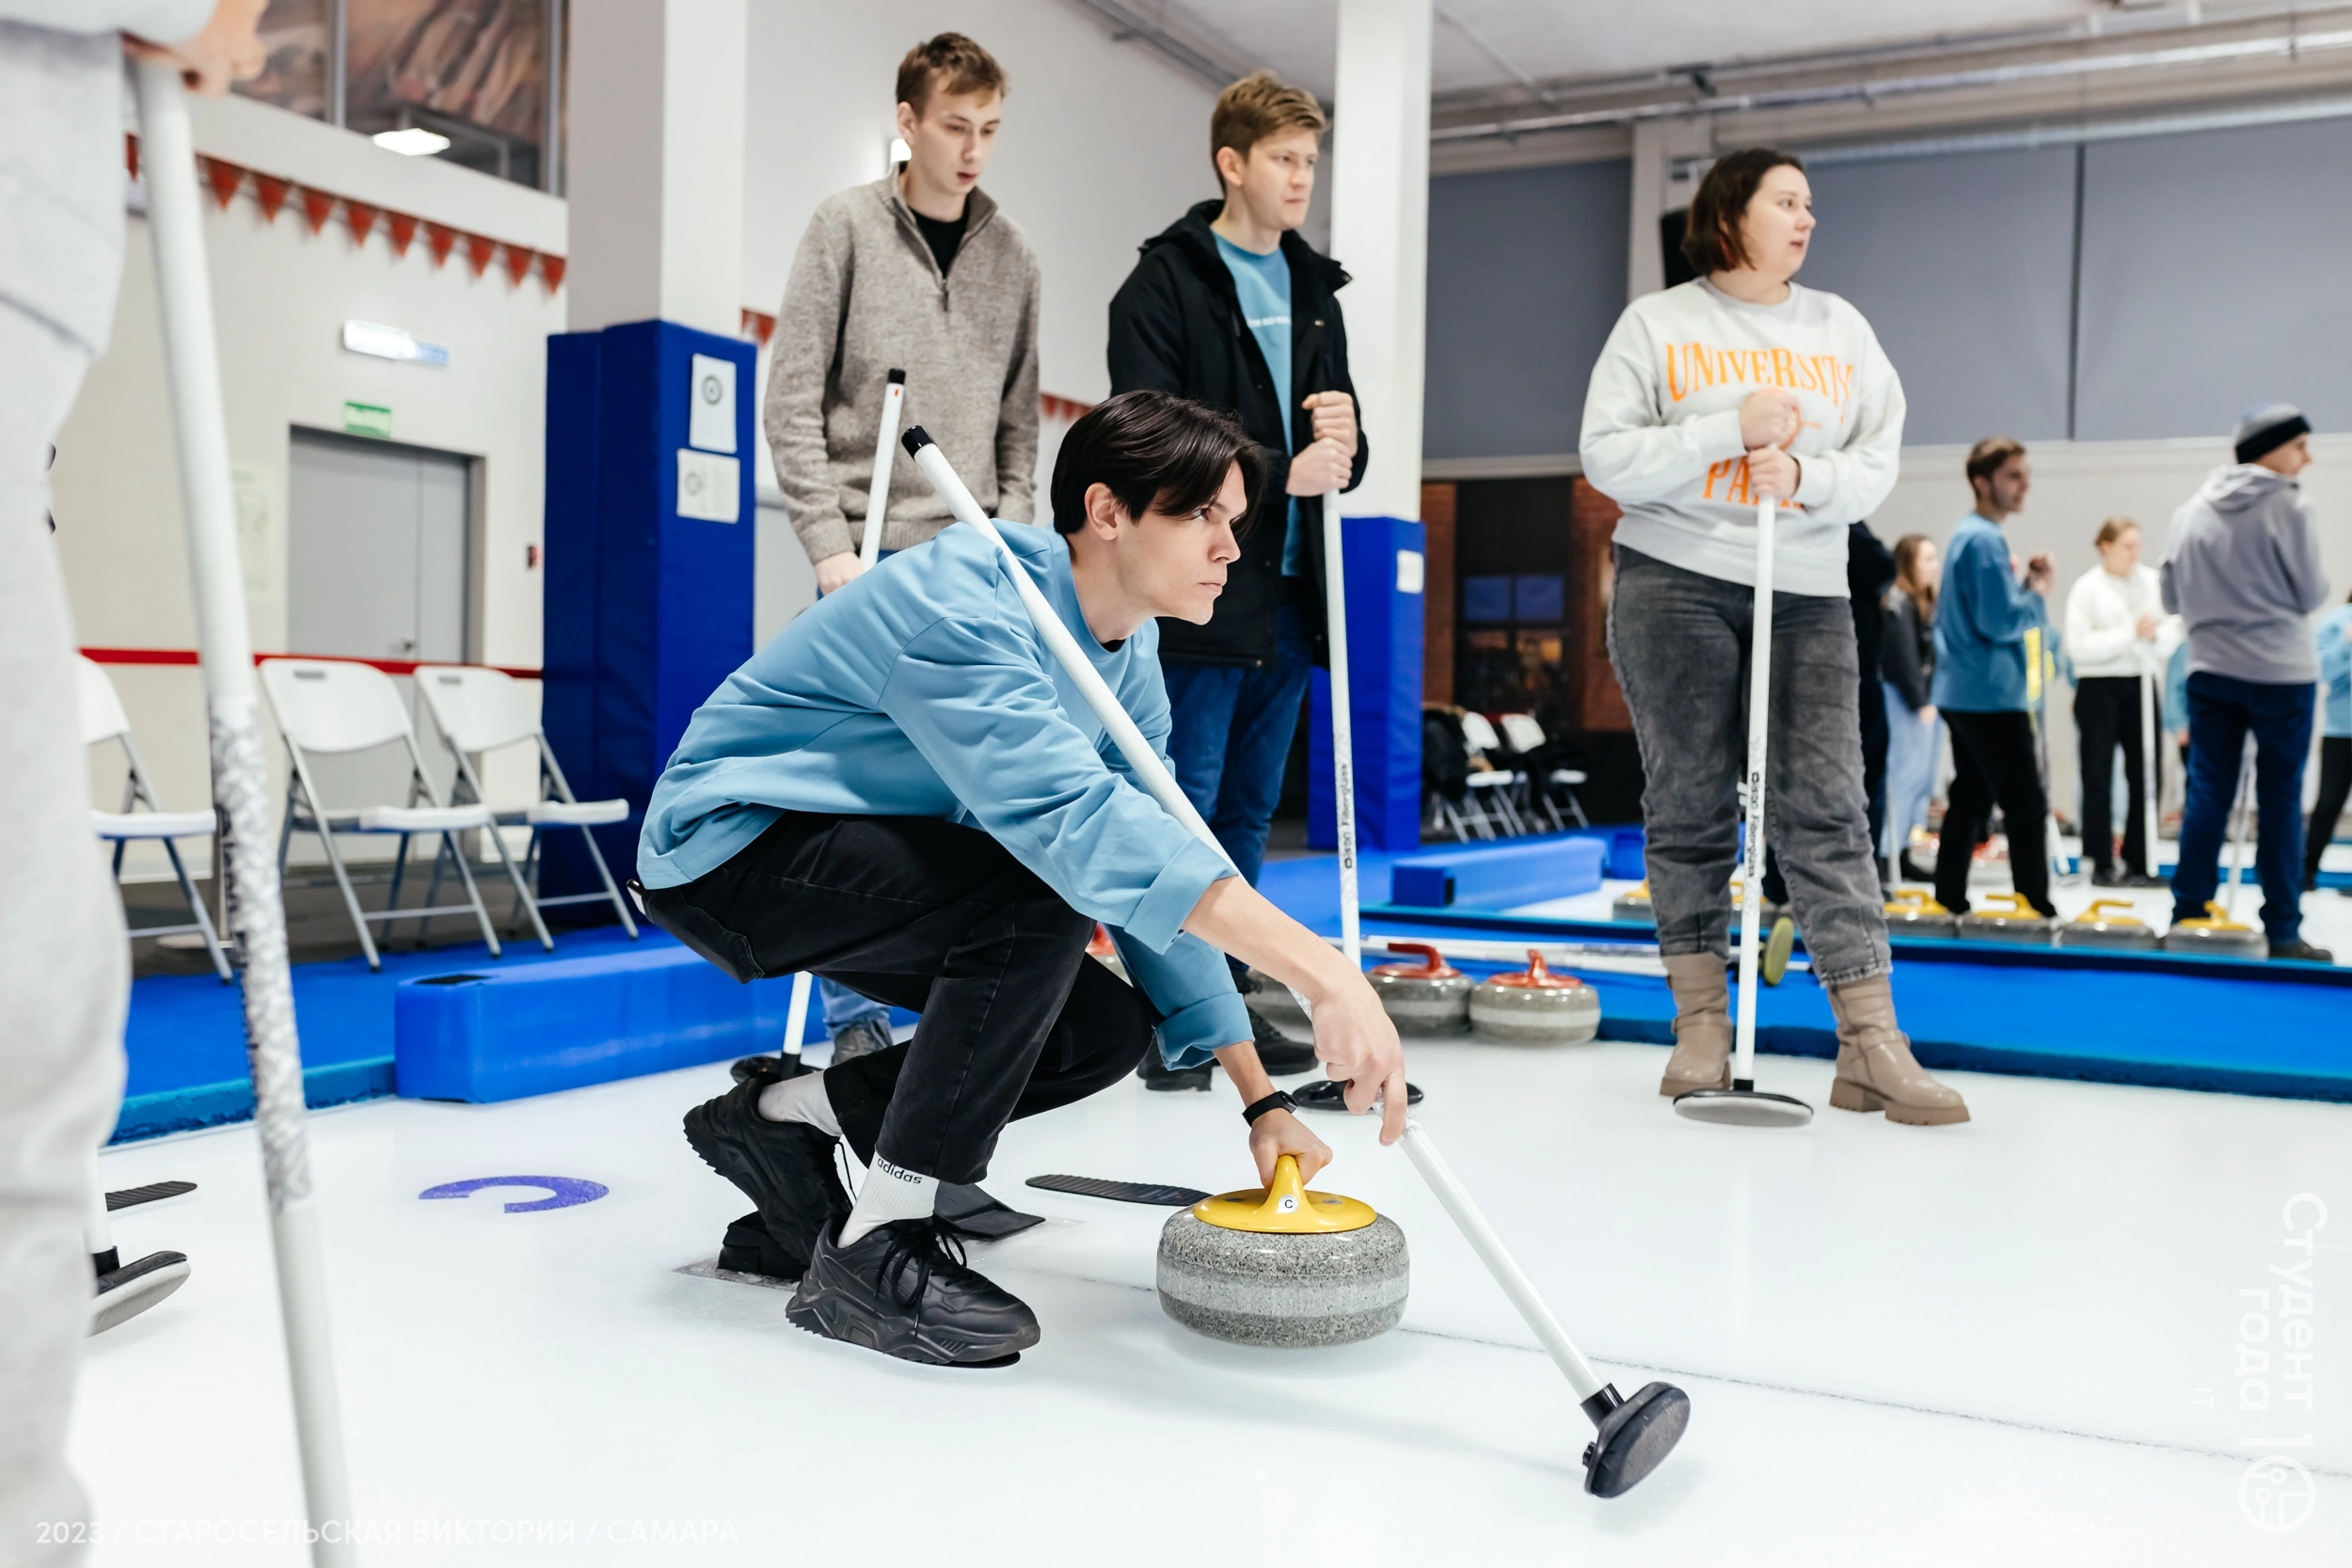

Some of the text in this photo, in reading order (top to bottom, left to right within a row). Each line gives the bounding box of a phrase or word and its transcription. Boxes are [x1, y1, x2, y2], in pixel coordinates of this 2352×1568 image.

[1665, 341, 1853, 424] UNIVERSITY
[877, 1158, 923, 1184] adidas
[1284, 1199, 1294, 1209] C
